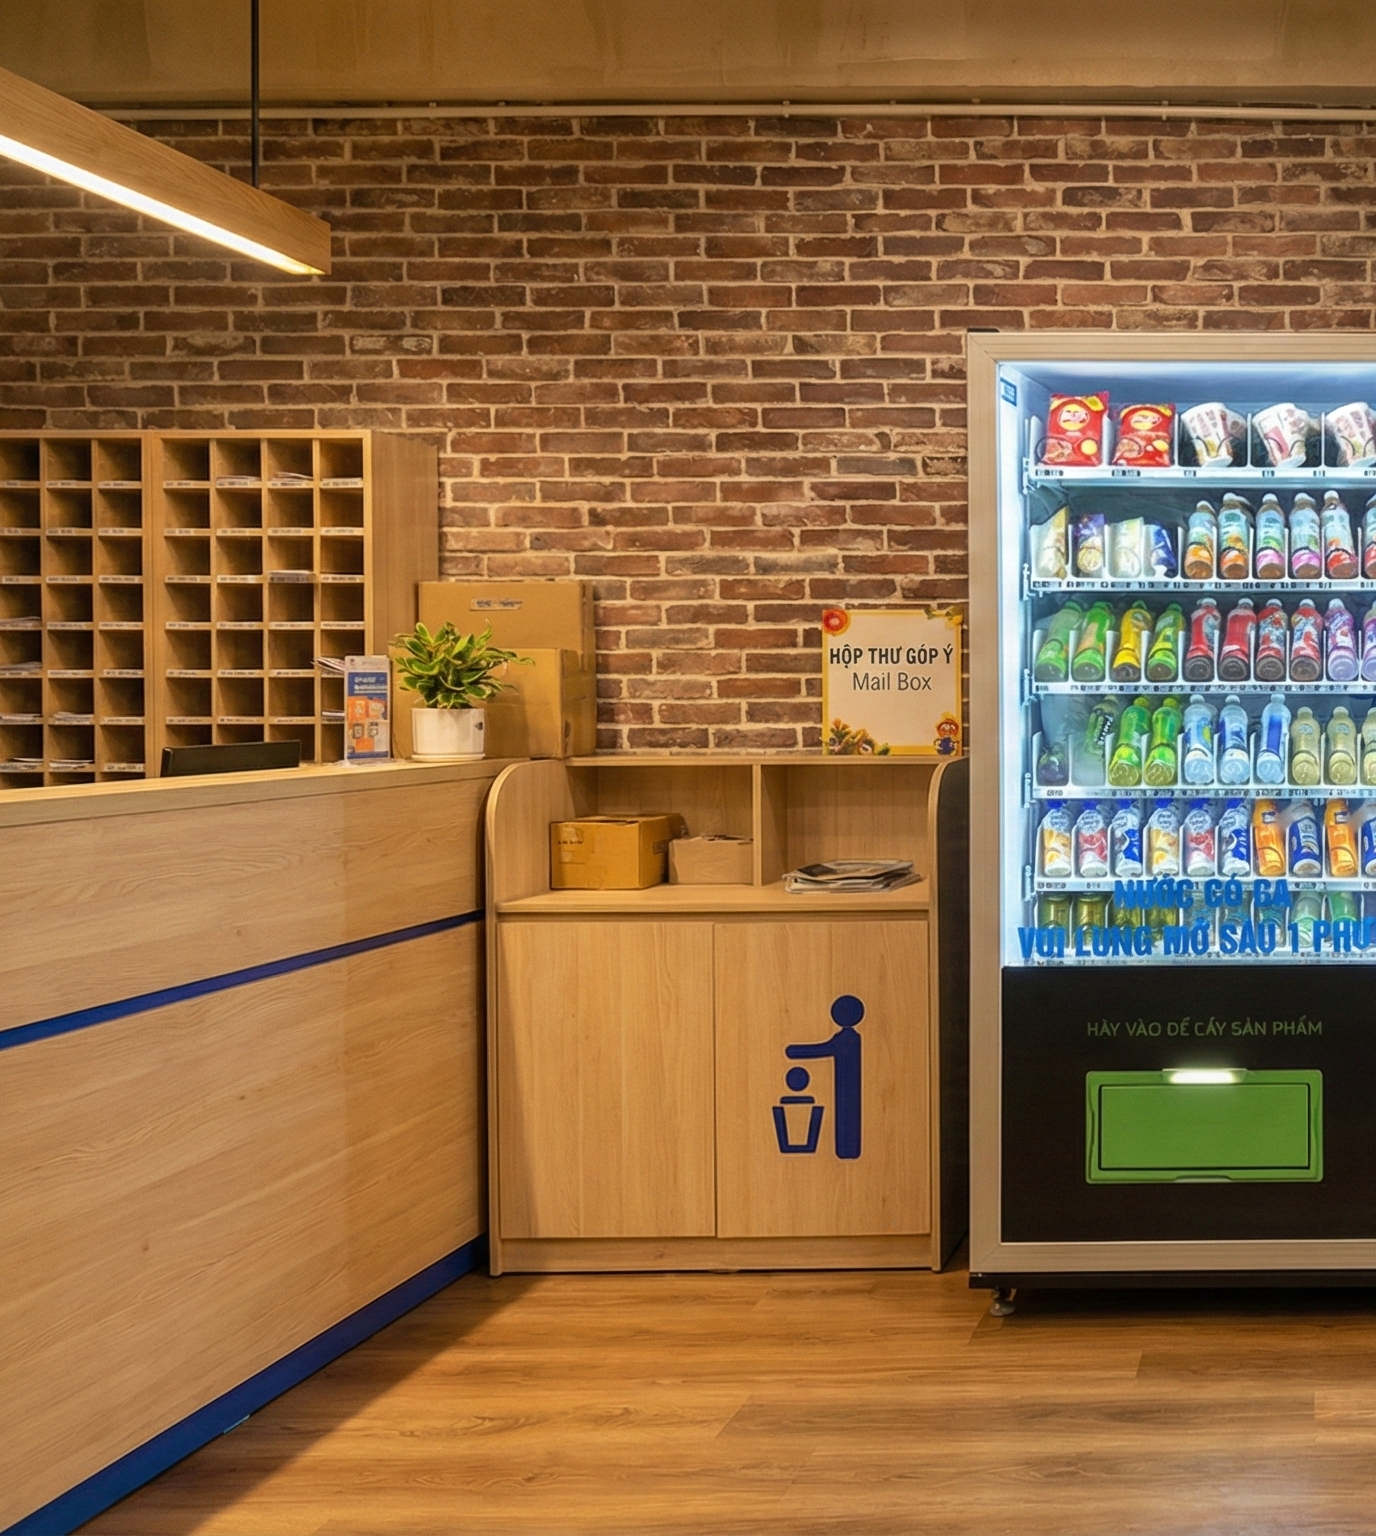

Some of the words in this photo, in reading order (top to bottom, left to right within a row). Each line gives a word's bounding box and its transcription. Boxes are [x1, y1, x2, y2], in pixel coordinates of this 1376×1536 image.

[830, 644, 863, 668] HỘP
[868, 646, 902, 665] THƯ
[906, 643, 939, 665] GÓP
[943, 643, 954, 664] Ý
[853, 672, 890, 691] Mail
[898, 672, 932, 691] Box
[1287, 922, 1299, 953] 1
[1125, 1018, 1162, 1037] VÀO
